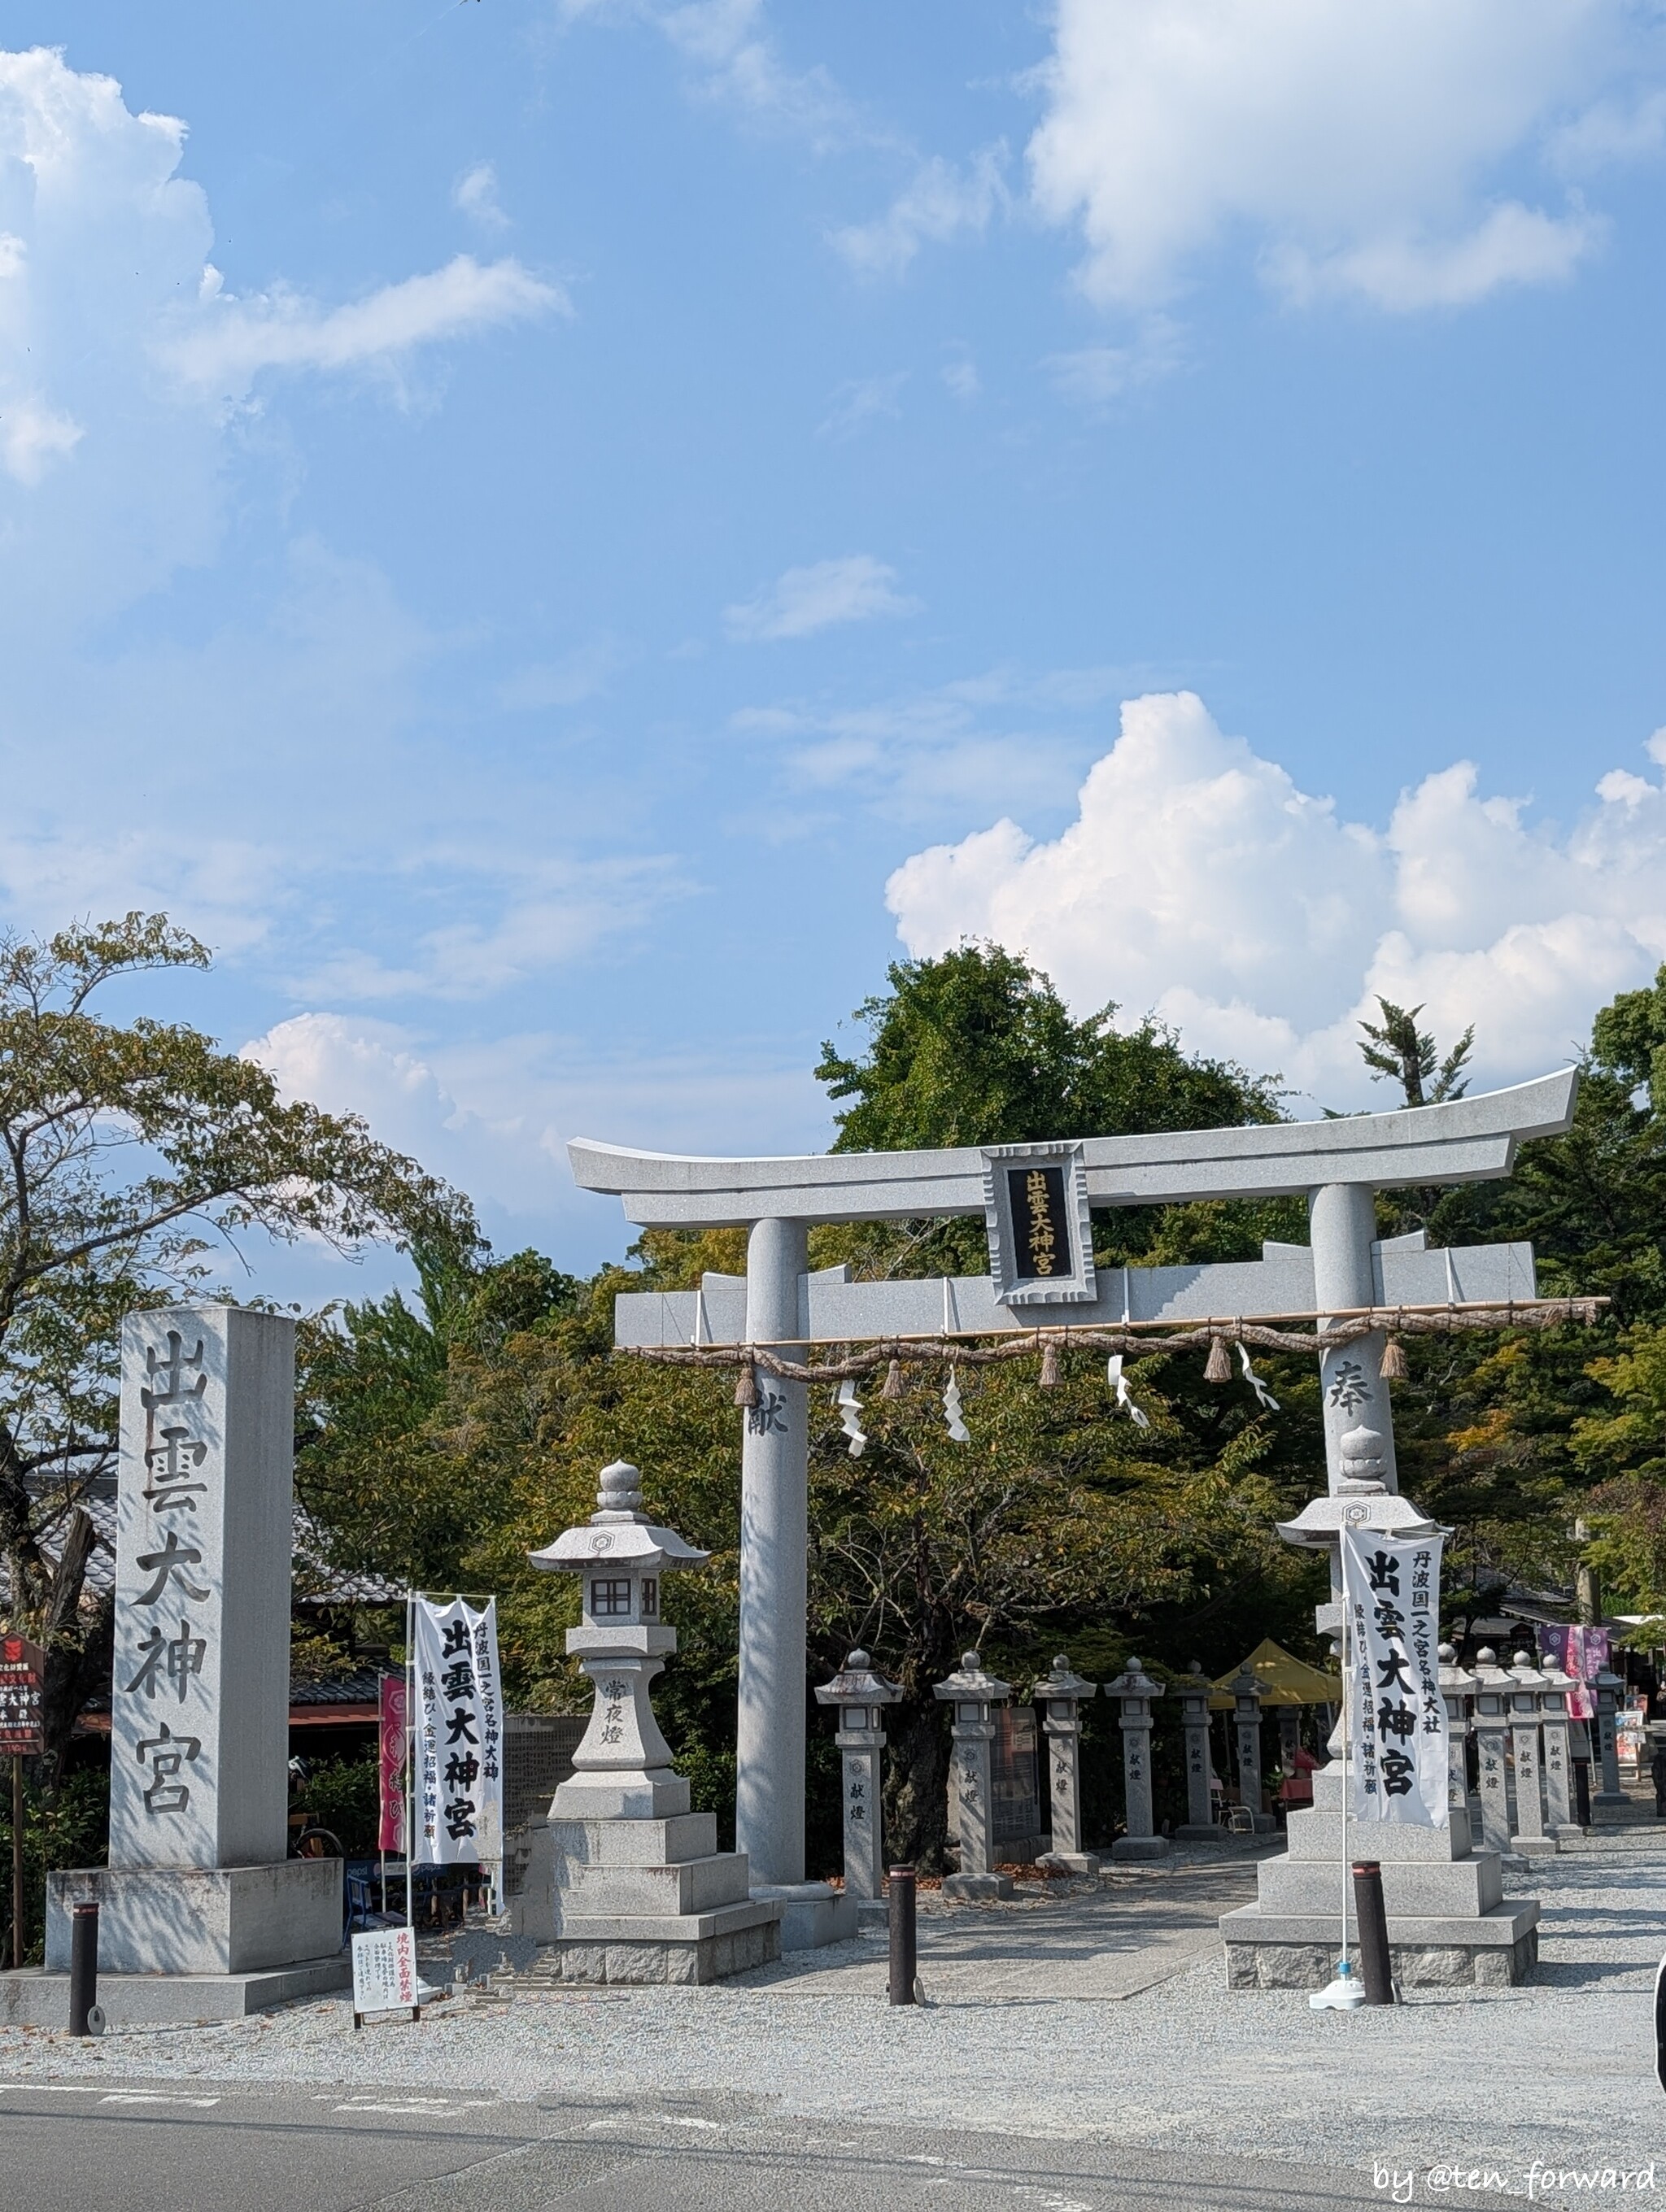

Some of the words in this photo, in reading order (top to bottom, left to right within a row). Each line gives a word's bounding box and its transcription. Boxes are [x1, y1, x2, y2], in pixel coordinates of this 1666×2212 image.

[1026, 1169, 1057, 1276] 出雲大神宮
[748, 1388, 789, 1437] 献
[1330, 1361, 1374, 1417] 奉
[124, 1330, 210, 1815] 出雲大神宮
[1410, 1551, 1441, 1735] 丹波国一之宮名神大社
[1363, 1550, 1417, 1797] 出雲大神宮
[441, 1619, 480, 1841] 出雲大神宮
[600, 1680, 626, 1745] 常夜燈
[1055, 1761, 1068, 1791] 献燈
[1129, 1753, 1141, 1781] 献燈
[1191, 1748, 1203, 1773] 献燈
[1485, 1757, 1500, 1789] 献燈
[1520, 1749, 1533, 1779] 献燈
[1550, 1745, 1562, 1771] 献燈
[850, 1783, 866, 1820] 献燈
[965, 1770, 979, 1802] 献燈
[396, 1932, 412, 2003] 境内全面禁煙
